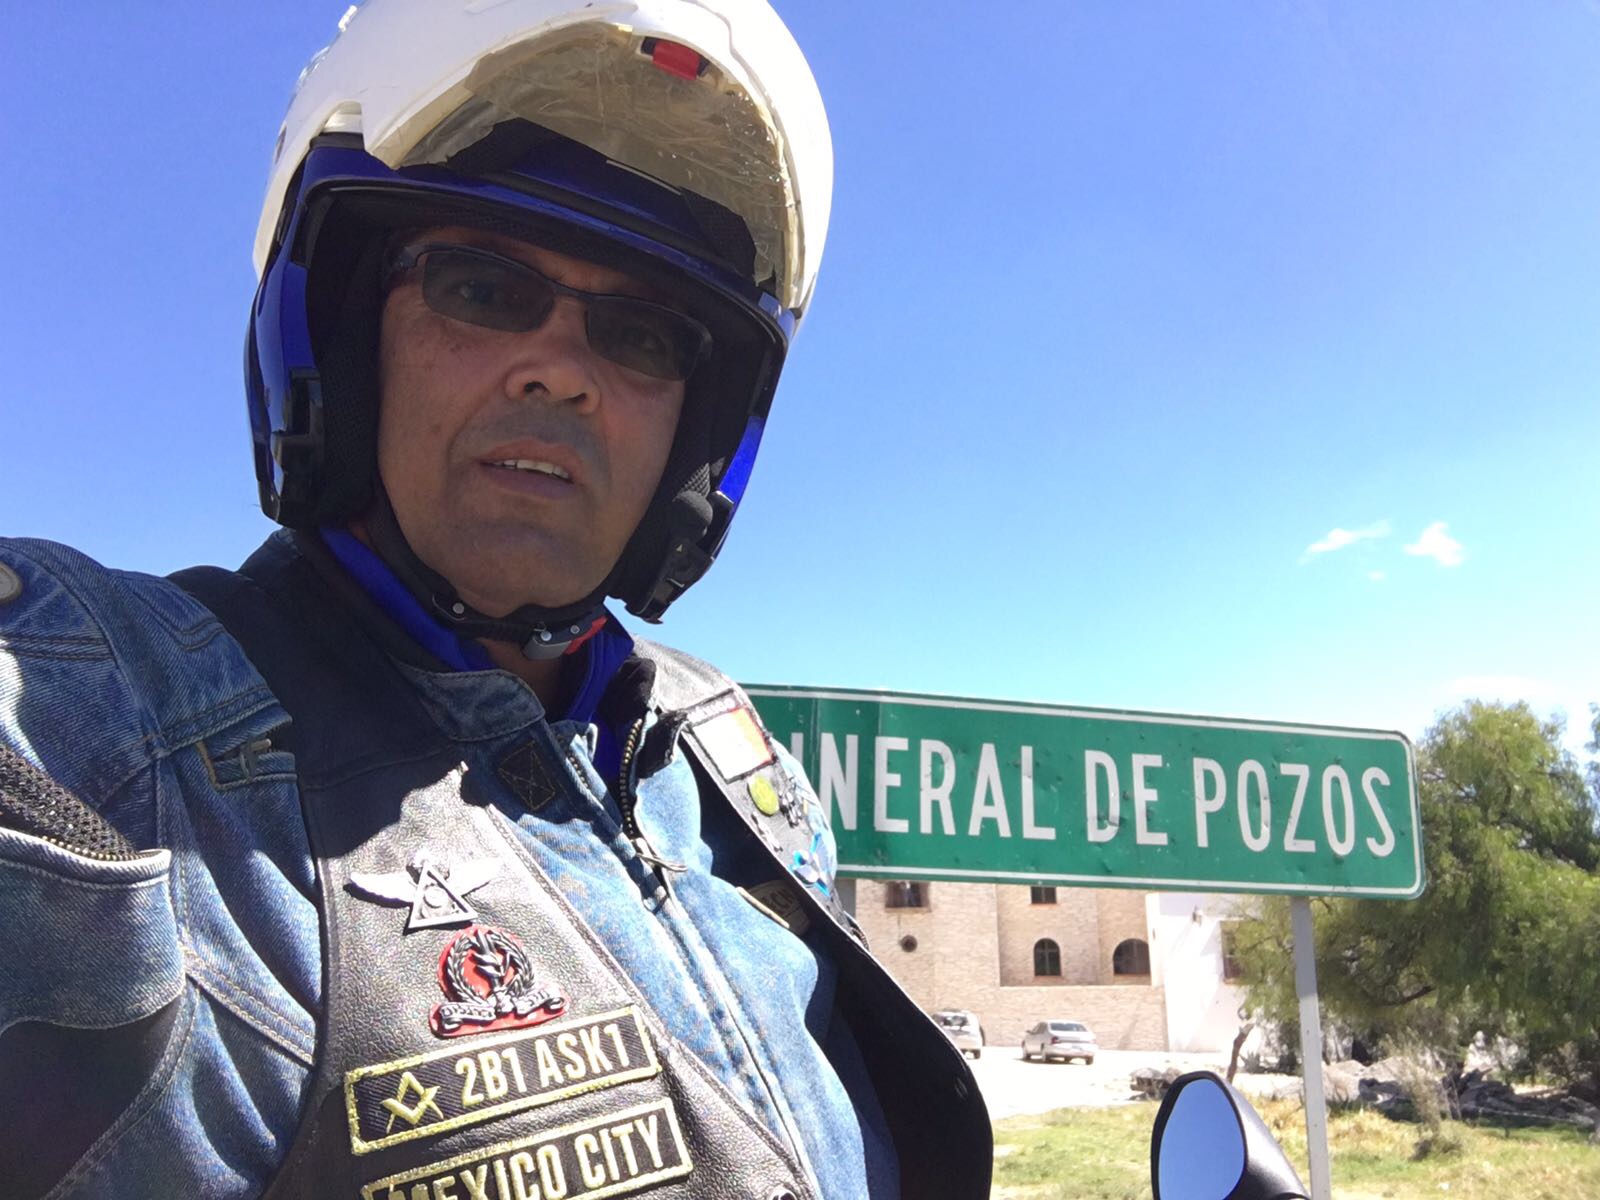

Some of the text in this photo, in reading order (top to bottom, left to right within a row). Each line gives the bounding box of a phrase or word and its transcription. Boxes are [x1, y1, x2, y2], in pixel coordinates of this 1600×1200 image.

[1083, 748, 1169, 846] DE
[1193, 756, 1396, 858] POZOS
[453, 1022, 631, 1108] 2B1 ASK1
[573, 1113, 664, 1190] CITY
